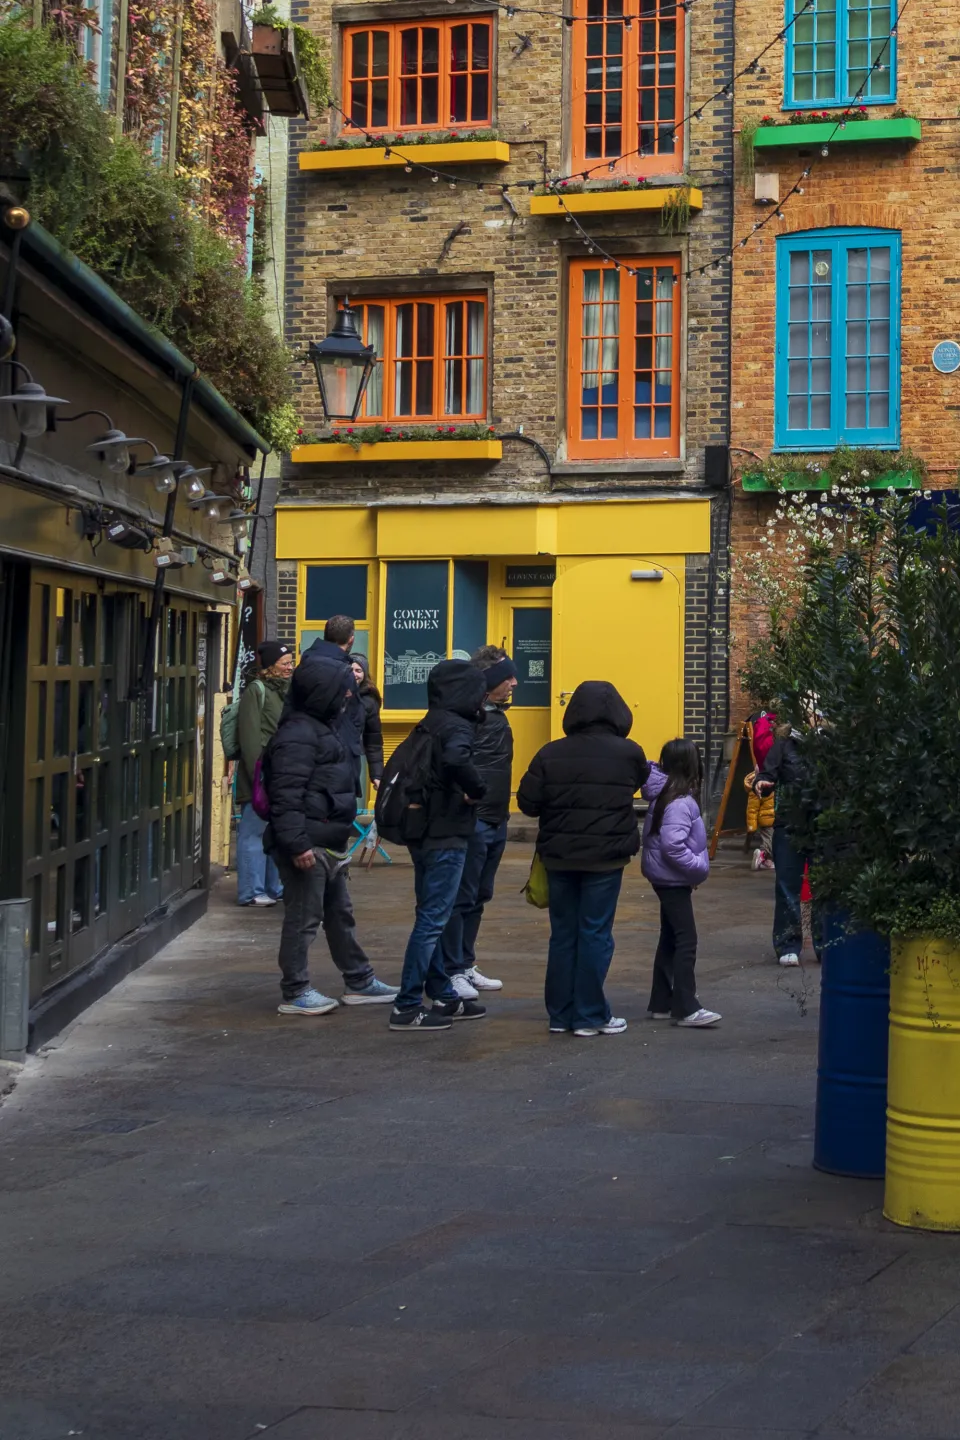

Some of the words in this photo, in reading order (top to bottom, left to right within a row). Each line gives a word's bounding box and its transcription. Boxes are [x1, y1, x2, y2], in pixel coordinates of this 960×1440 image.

[244, 606, 253, 622] ?
[393, 609, 440, 619] COVENT
[392, 619, 440, 630] GARDEN
